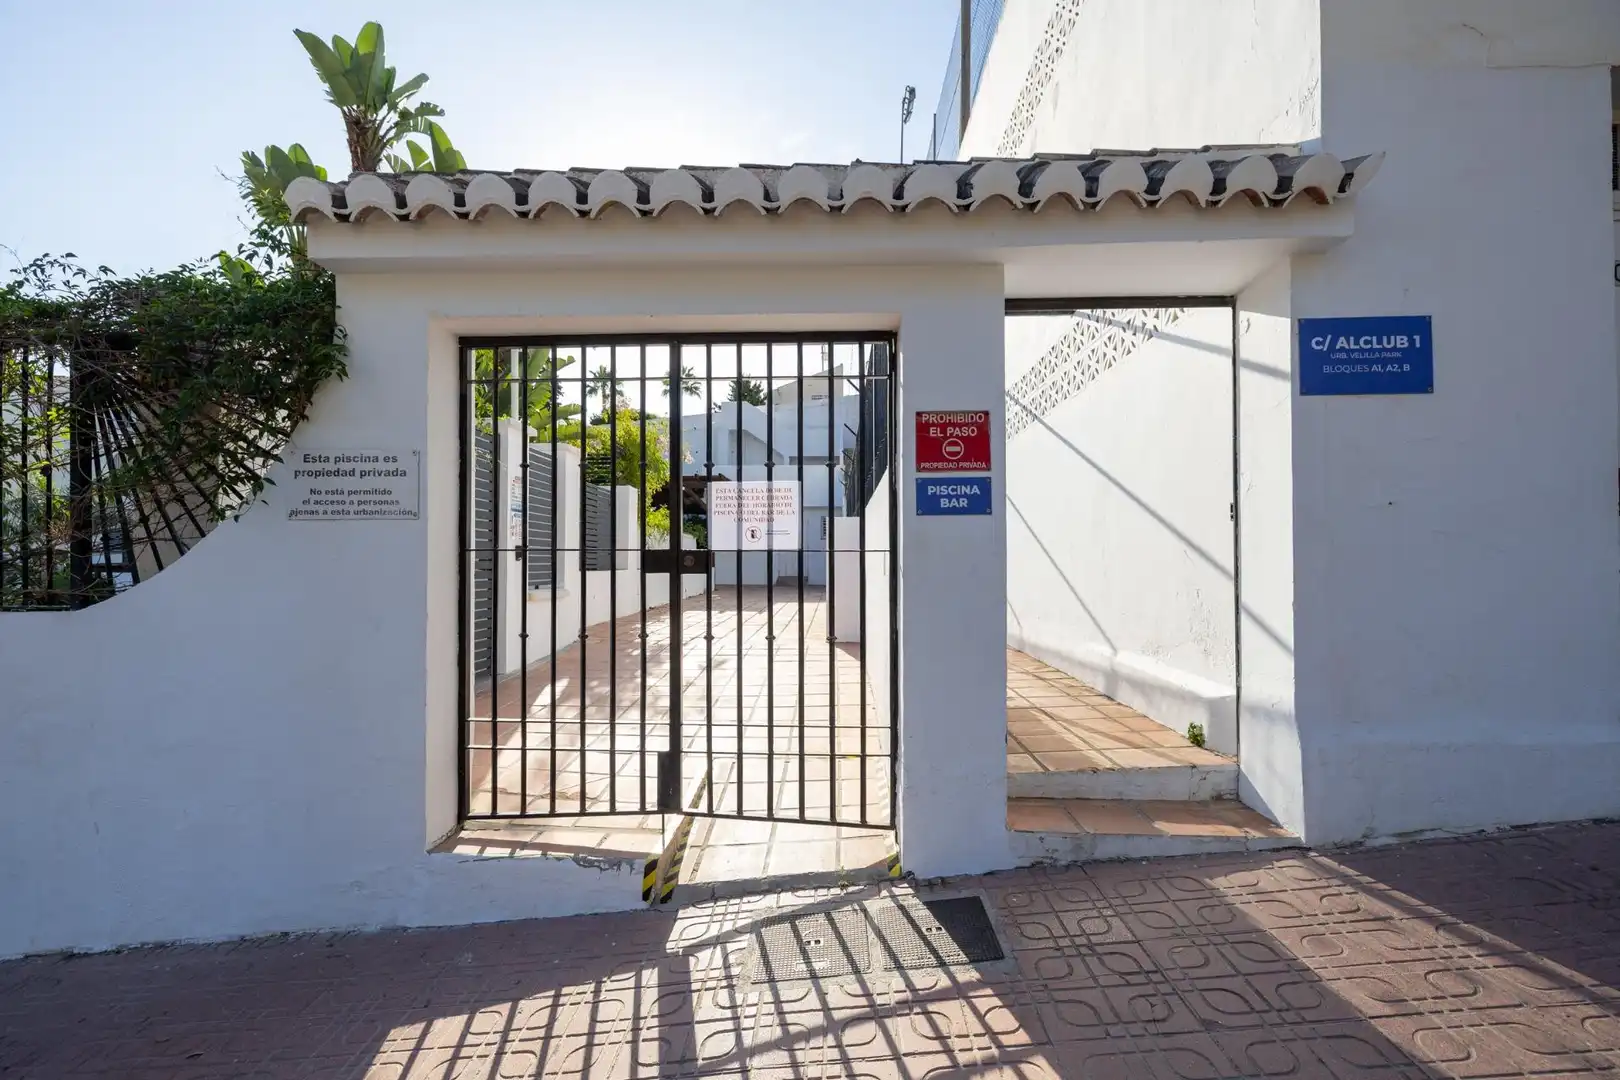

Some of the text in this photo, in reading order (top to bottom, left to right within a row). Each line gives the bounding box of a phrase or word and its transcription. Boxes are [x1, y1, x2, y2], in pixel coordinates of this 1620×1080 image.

[1311, 334, 1421, 351] C/ ALCLUB 1
[1323, 364, 1369, 374] BLOQUES
[1403, 364, 1410, 372] B
[922, 413, 984, 424] PROHIBIDO
[929, 426, 978, 436] EL PASO
[303, 454, 330, 463] Esta
[334, 454, 379, 465] piscina
[294, 468, 407, 479] propiedad privada
[325, 488, 344, 496] está
[348, 488, 392, 497] permitido
[928, 485, 980, 495] PISCINA
[302, 498, 310, 506] el
[358, 499, 400, 507] personas
[940, 498, 968, 508] BAR
[330, 508, 350, 516] esta
